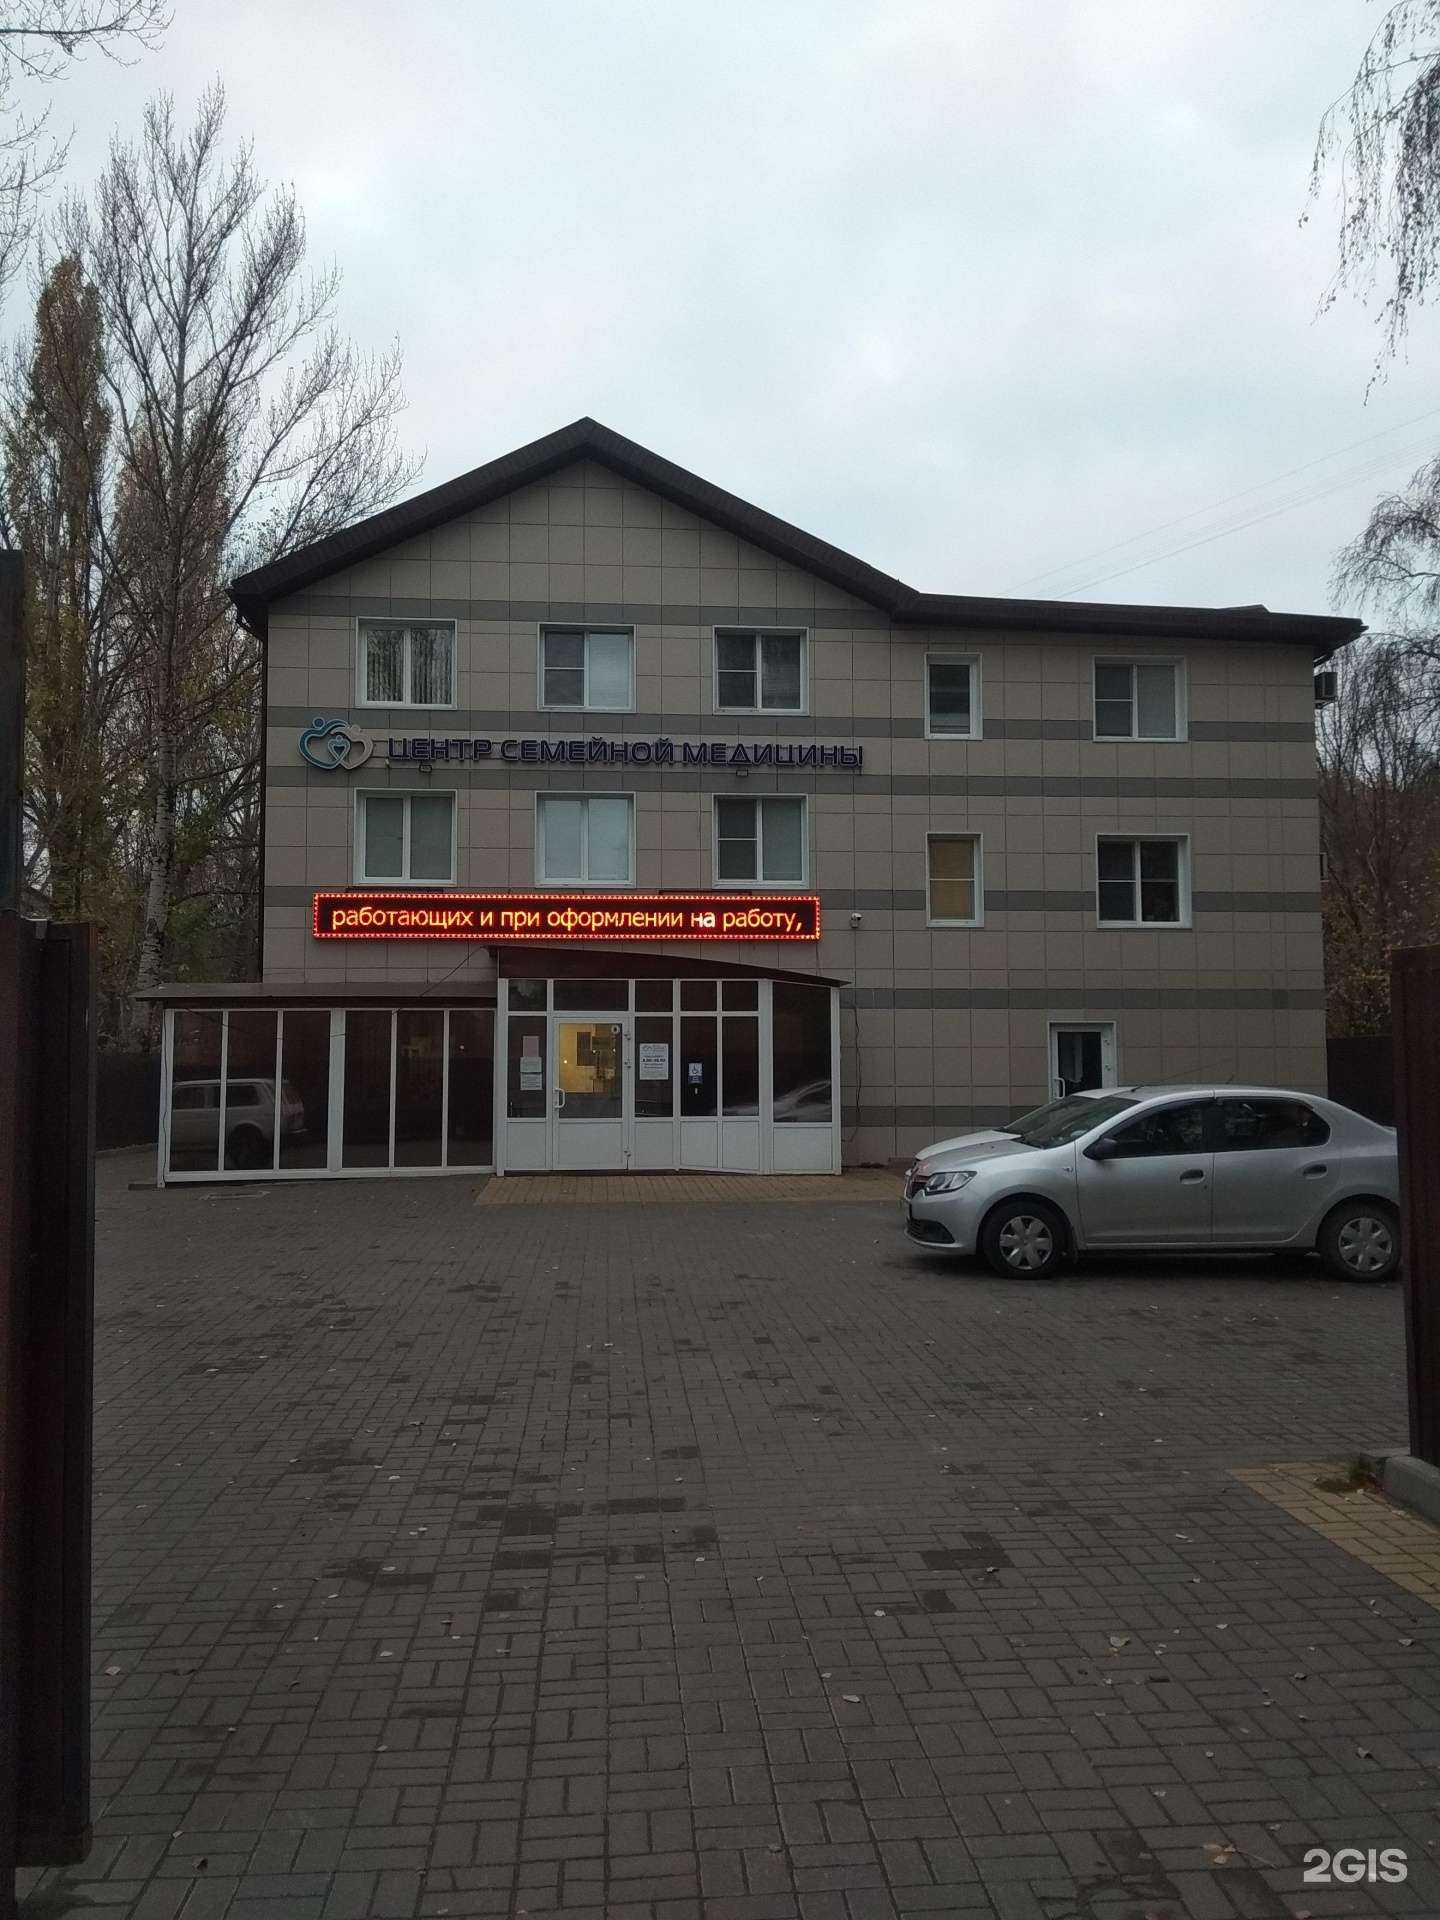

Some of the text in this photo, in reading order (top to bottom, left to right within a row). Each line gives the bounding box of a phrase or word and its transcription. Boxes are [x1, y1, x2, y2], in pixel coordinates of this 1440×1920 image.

[387, 736, 864, 769] ЦЕНТР СЕМЕЙНОЙ МЕДИЦИНЫ
[331, 906, 803, 932] работающих и при оформлении на работу,
